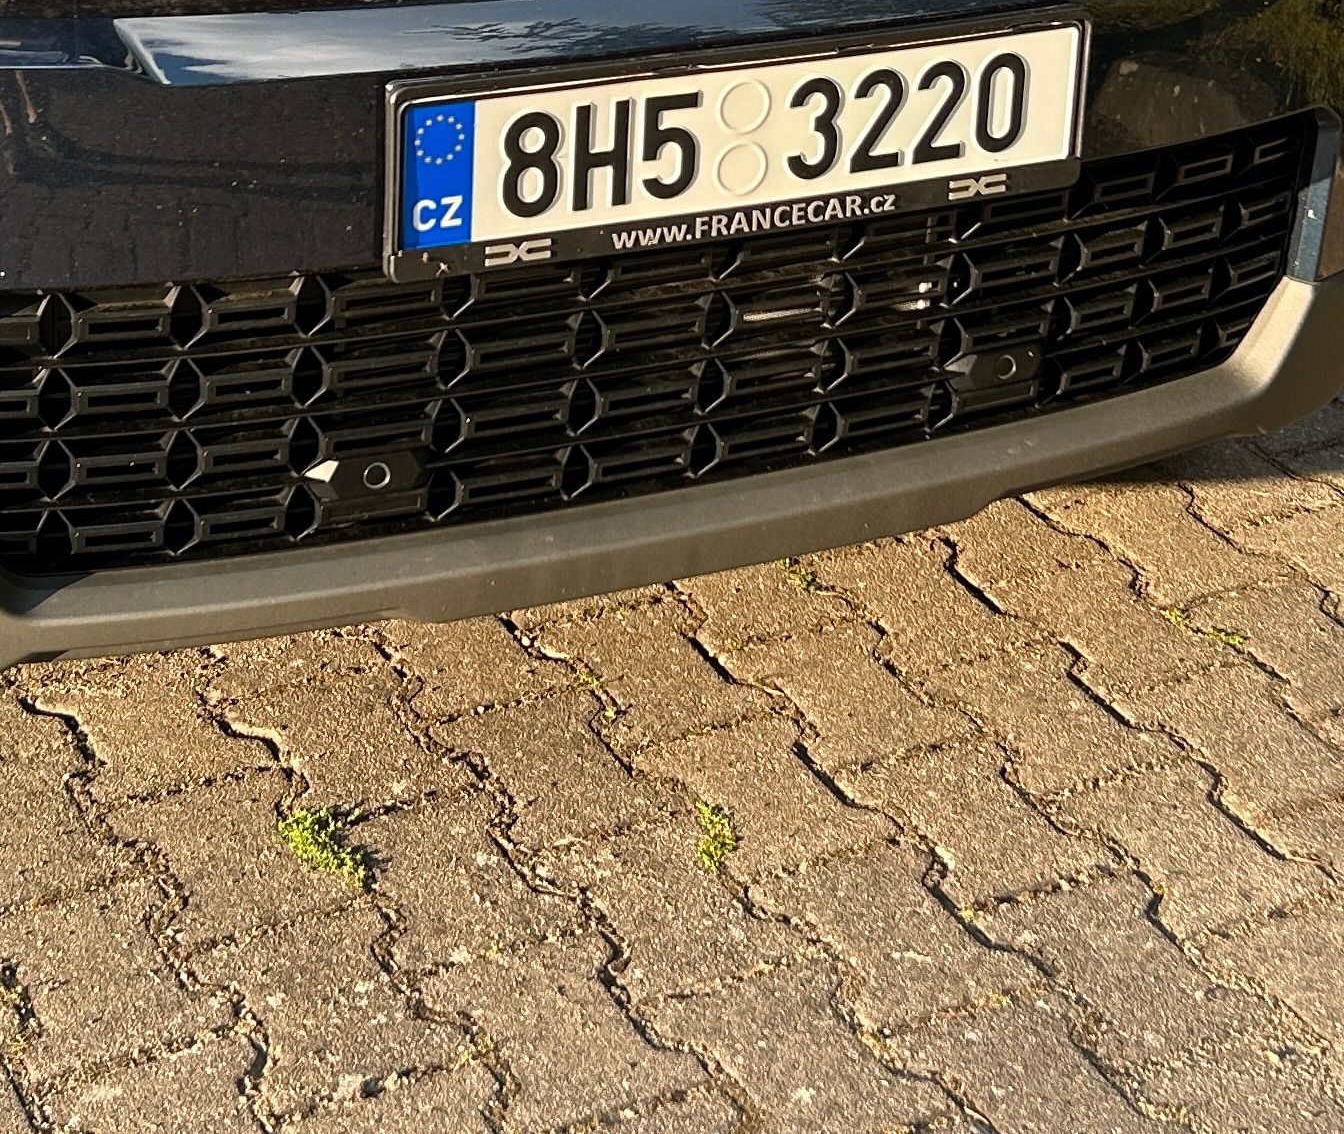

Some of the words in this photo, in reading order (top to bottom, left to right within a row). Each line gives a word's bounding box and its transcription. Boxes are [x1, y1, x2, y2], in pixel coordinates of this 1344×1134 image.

[502, 89, 704, 218] 8H5
[786, 51, 1027, 180] 3220
[412, 194, 464, 233] CZ
[611, 193, 896, 250] www.FRANCECAR.cz
